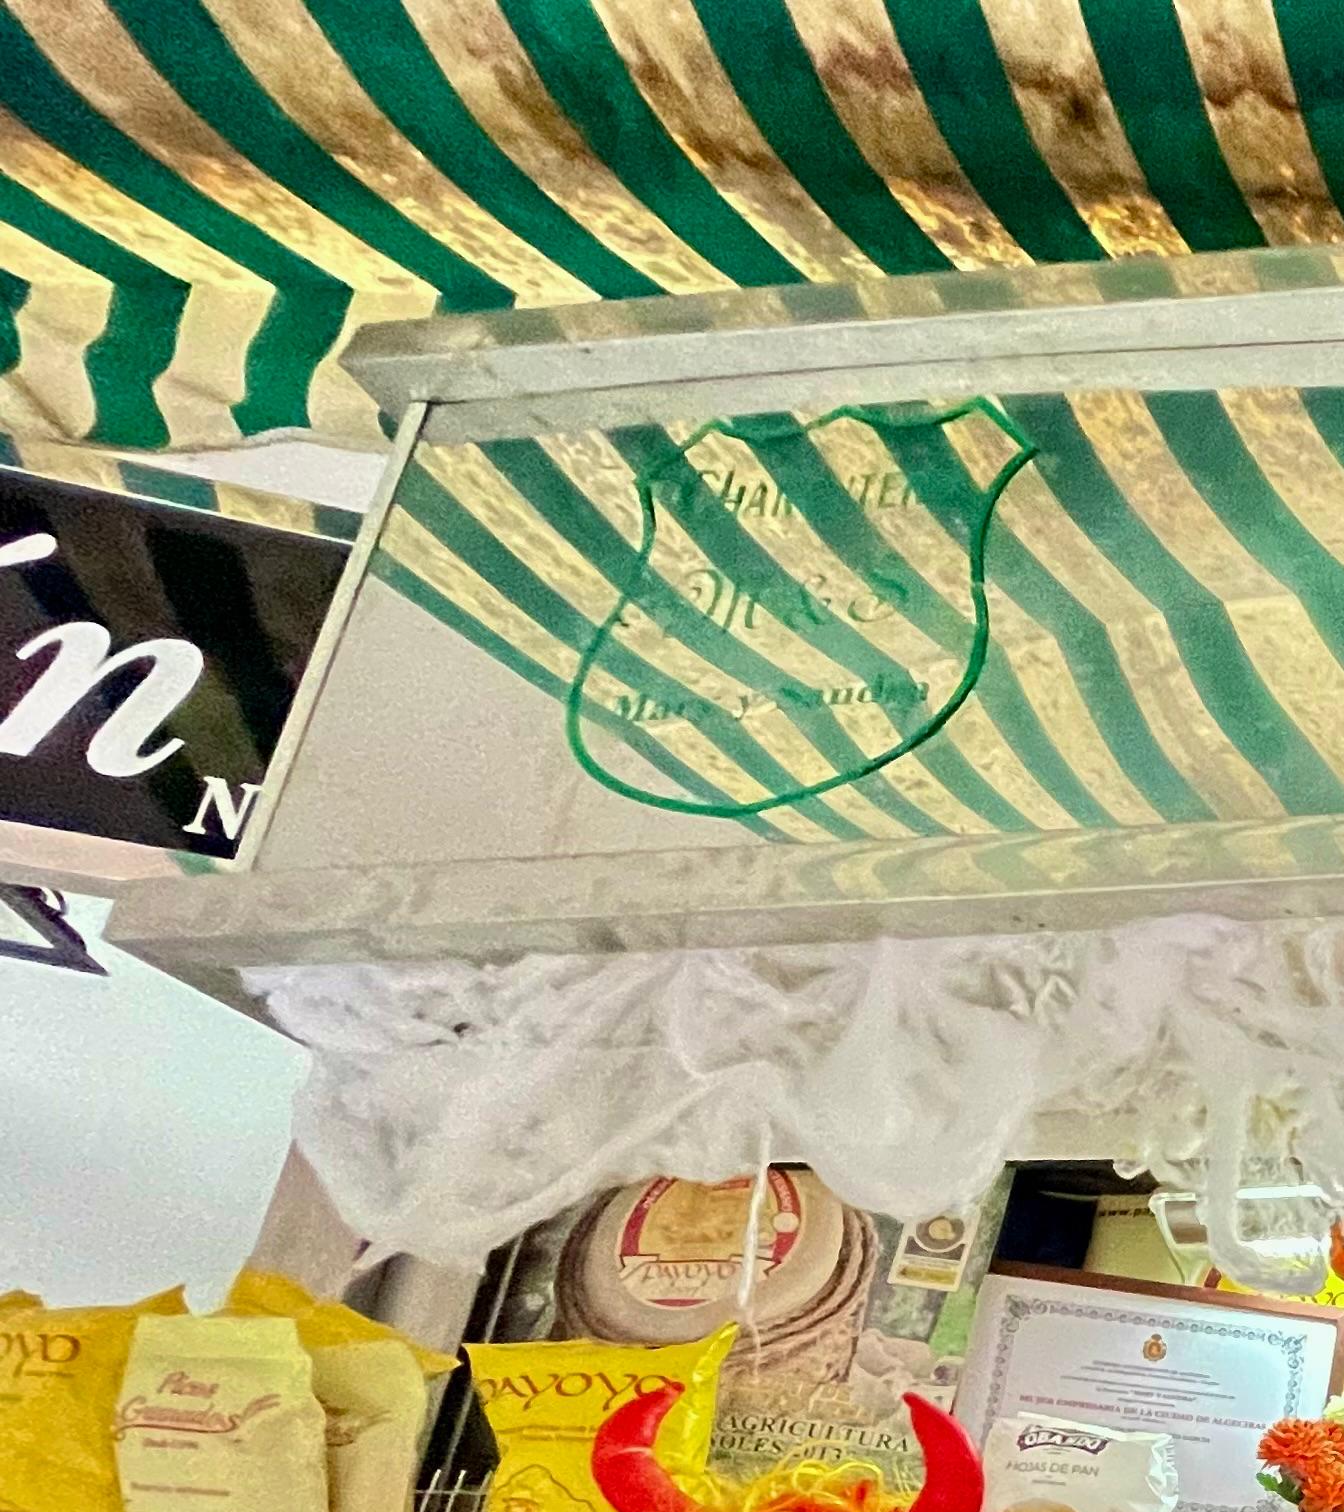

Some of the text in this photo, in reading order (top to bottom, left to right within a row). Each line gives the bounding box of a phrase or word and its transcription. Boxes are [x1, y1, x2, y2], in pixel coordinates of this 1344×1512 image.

[723, 1414, 909, 1452] AGRICULTURA
[1006, 1460, 1100, 1477] HOJAS DE PAN
